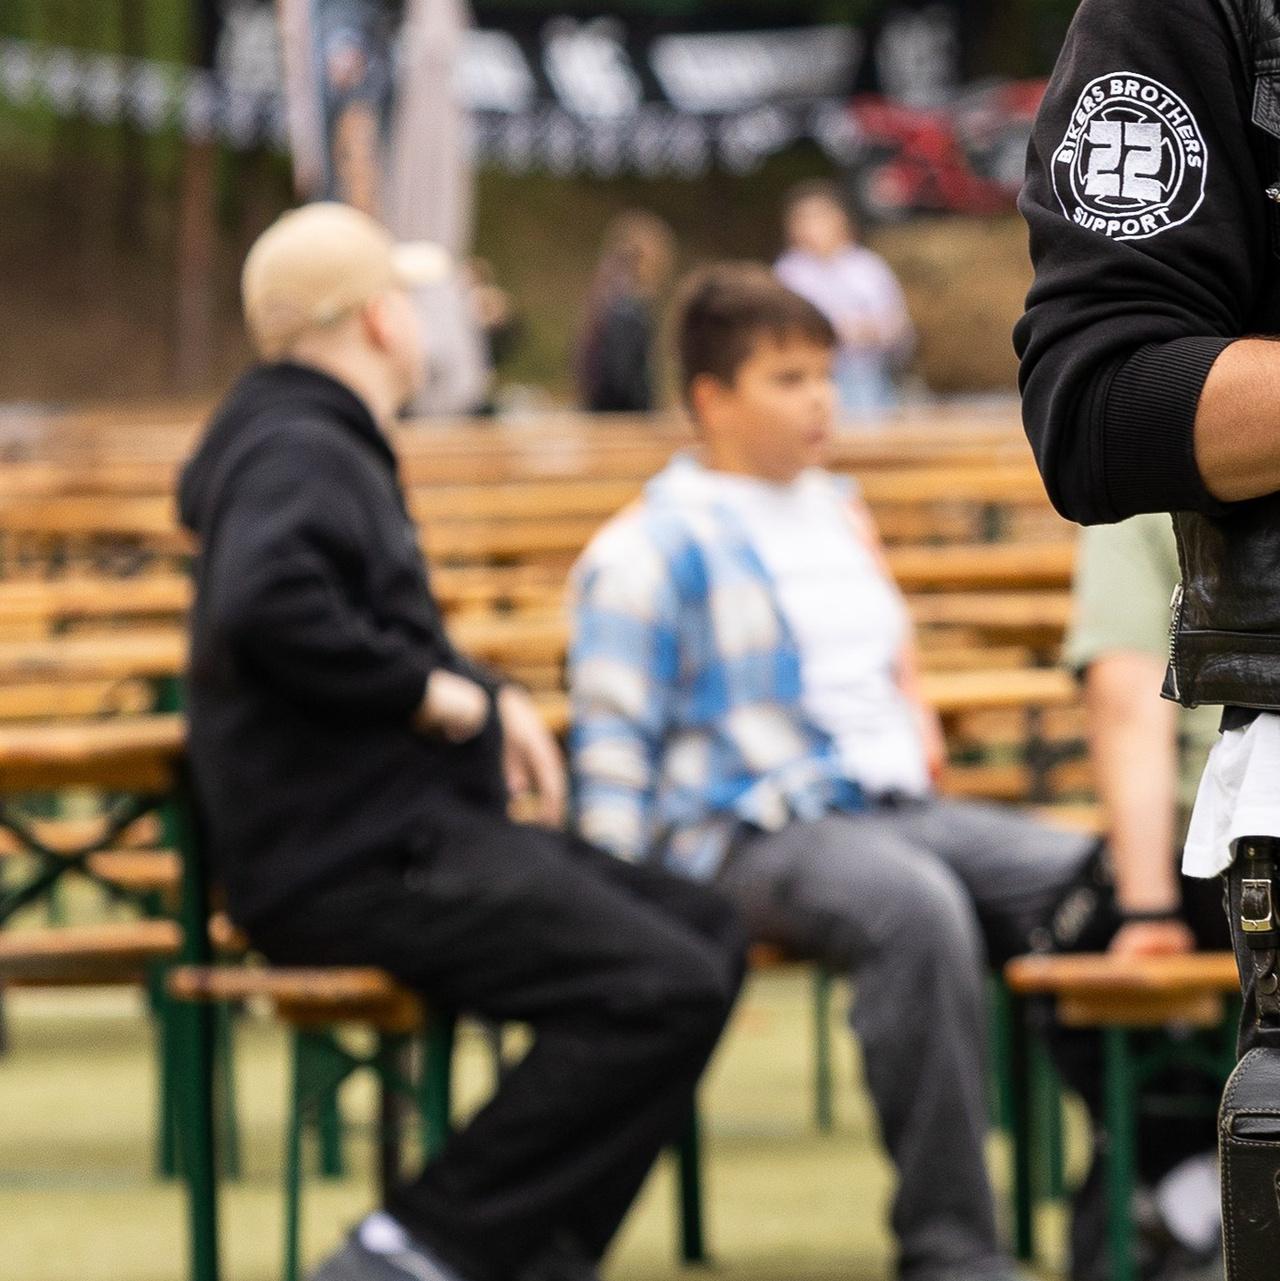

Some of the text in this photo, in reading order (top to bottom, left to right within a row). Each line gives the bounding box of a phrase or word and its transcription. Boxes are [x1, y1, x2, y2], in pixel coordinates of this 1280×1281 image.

[1056, 79, 1202, 169] BIKERS BROTHERS
[1084, 120, 1162, 202] 22
[1073, 206, 1171, 237] SUPPORT
